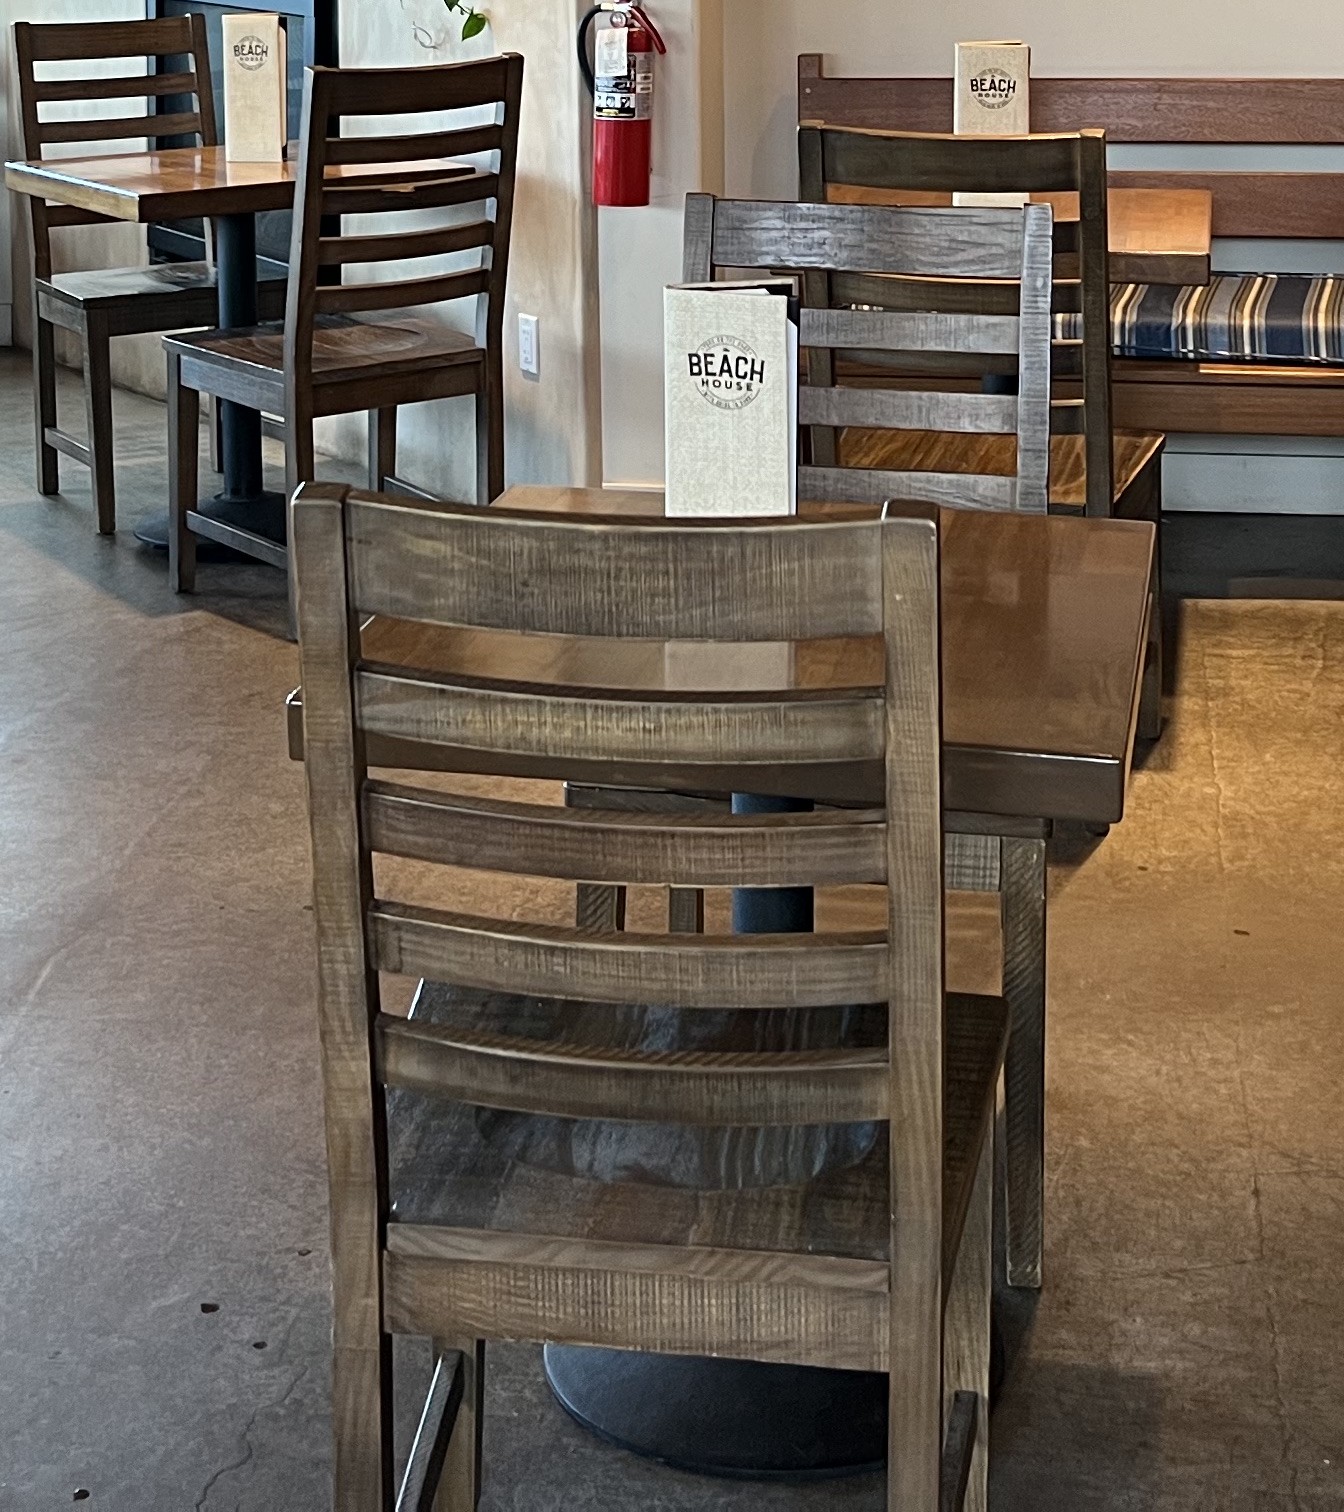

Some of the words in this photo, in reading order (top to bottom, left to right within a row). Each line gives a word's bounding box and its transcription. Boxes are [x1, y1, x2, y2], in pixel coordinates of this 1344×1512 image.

[233, 44, 268, 57] BEACH
[970, 78, 1016, 93] BEACH
[687, 352, 765, 384] BEACH
[701, 378, 753, 392] HOUSE
